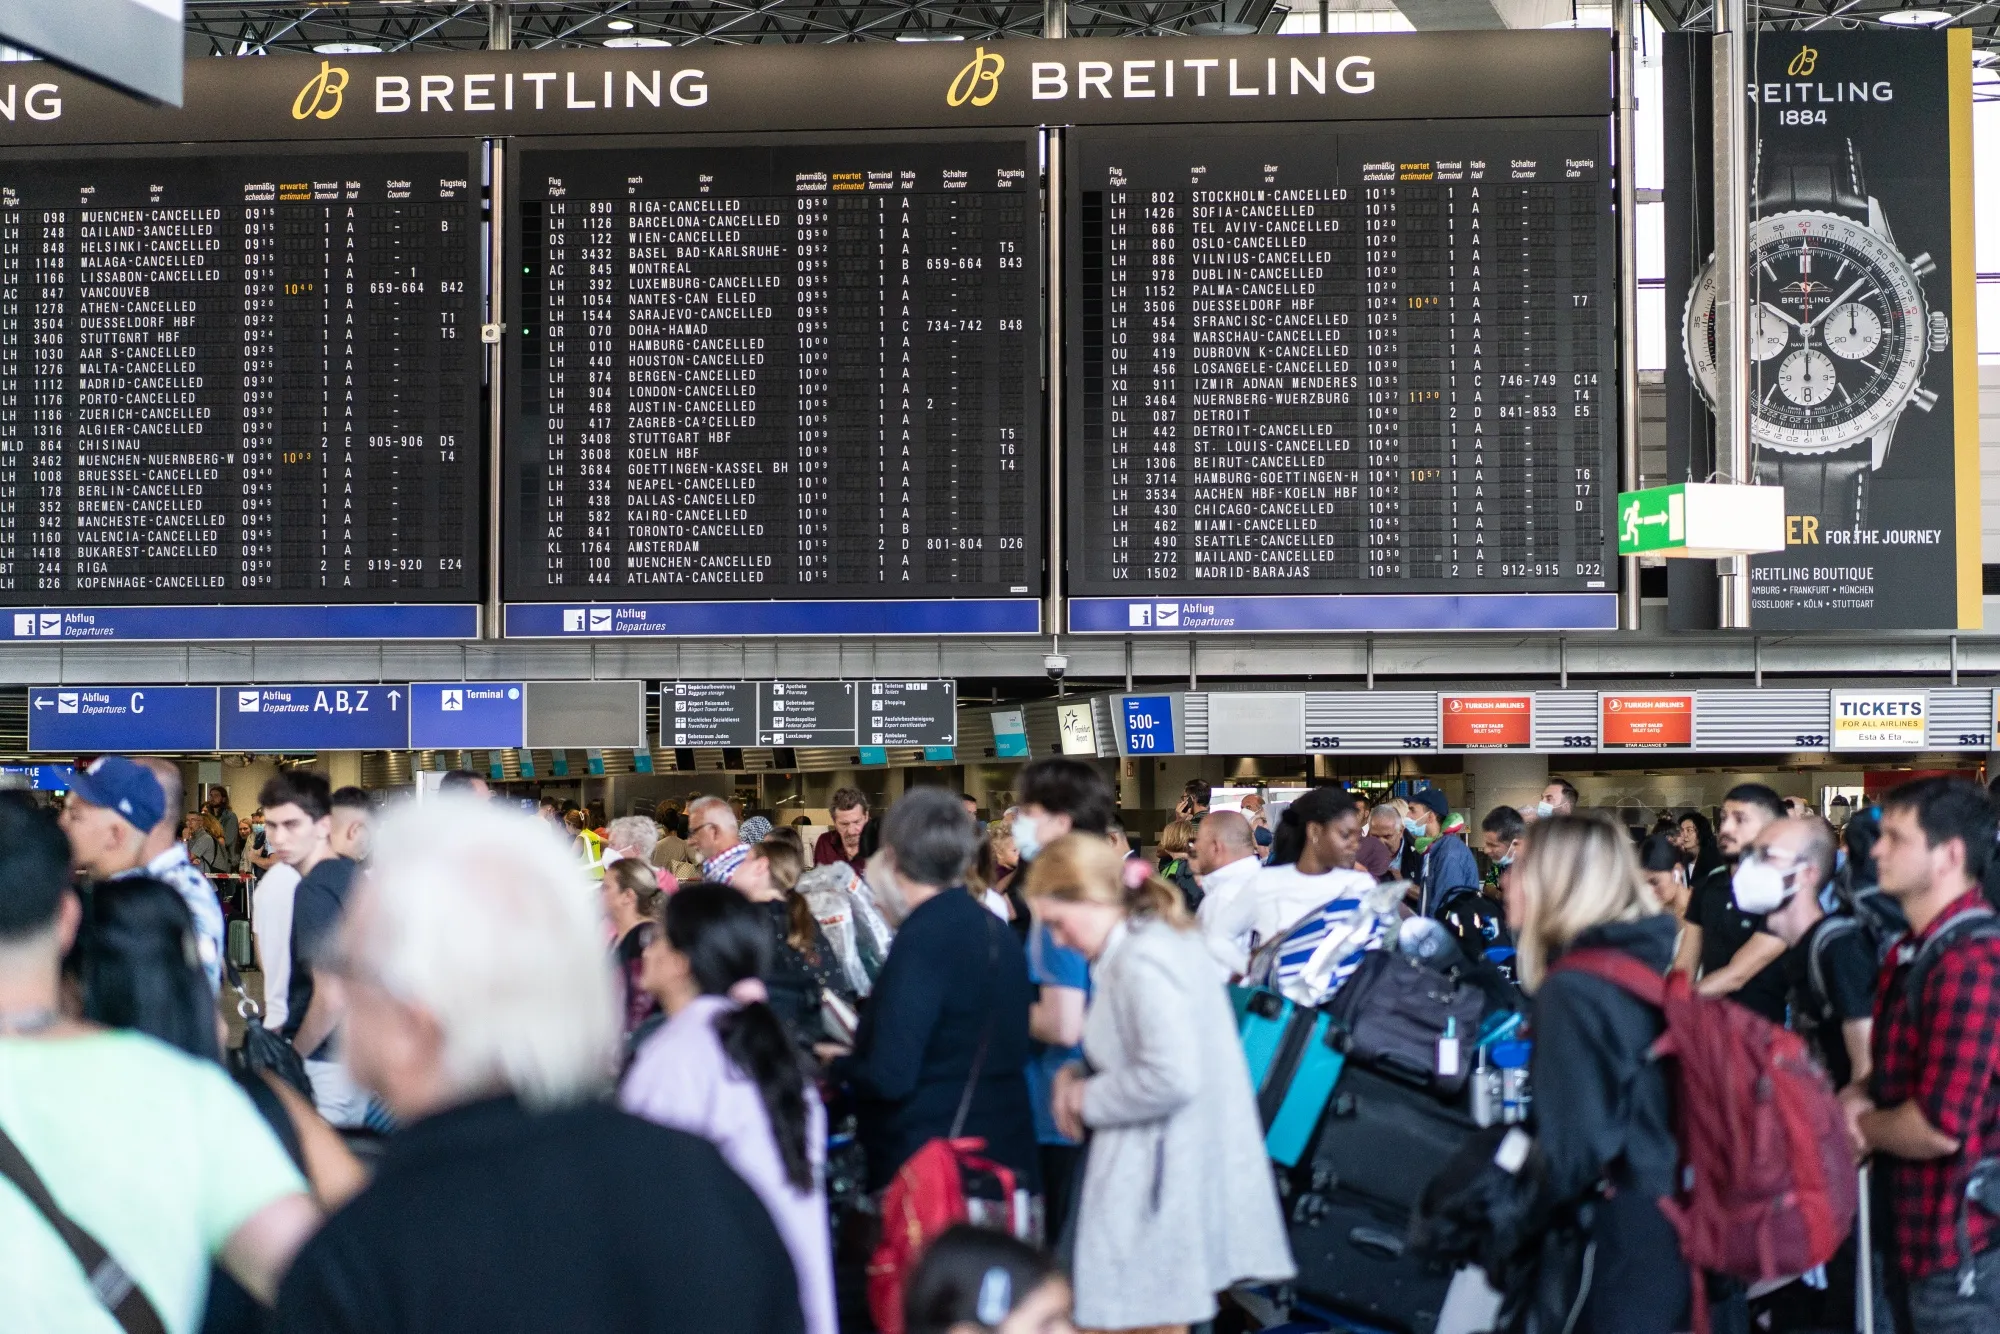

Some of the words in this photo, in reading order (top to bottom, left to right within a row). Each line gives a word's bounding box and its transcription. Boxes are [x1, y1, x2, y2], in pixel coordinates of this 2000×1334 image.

[1032, 56, 1374, 99] BREITLING
[376, 69, 707, 112] BREITLING
[1747, 81, 1894, 102] REITLING
[1779, 109, 1828, 126] 1884
[1364, 162, 1394, 172] planmäßig
[440, 180, 466, 188] Flugsteig
[549, 177, 561, 186] Flug
[1193, 189, 1346, 202] STOCKHOLM-CANCELLED
[6, 214, 18, 224] LH
[44, 212, 64, 223] 098
[82, 210, 220, 222] MUENCHEN-CANCELLED
[630, 215, 779, 228] BARCELONA-CANCELLED
[82, 240, 219, 252] HELSINKI-CANCELLED
[1193, 237, 1306, 249] OSLO-CANCELLED
[81, 255, 204, 267] MALAGA-CANCELLED
[550, 265, 564, 275] AC
[590, 264, 611, 274] 845
[630, 263, 690, 274] MONTREAL
[1000, 257, 1022, 268] B43
[36, 273, 63, 283] 1166
[82, 270, 219, 282] LISSABON-CANCELLED
[1193, 268, 1322, 280] DUBLIN-CANCELLED
[81, 287, 149, 297] VANCOUVEB
[371, 282, 424, 293] 659-664
[442, 282, 463, 292] B42
[81, 301, 195, 313] ATHEN-CANCELLED
[81, 317, 164, 328] DUESSELDORF
[174, 316, 195, 326] HBF
[441, 313, 454, 322] T1
[630, 324, 707, 335] DOHA-HAMAD
[928, 320, 981, 331] 734-742
[1000, 320, 1022, 330] B48
[630, 338, 764, 350] HAMBURG-CANCELLED
[80, 377, 202, 389] MADRID-CANCELLED
[1196, 378, 1233, 389] IZMIR
[1243, 378, 1282, 388] ADNAN
[1293, 377, 1356, 388] MENDERES
[1574, 374, 1597, 385] C14
[630, 385, 755, 397] LONDON-CANCELLED
[80, 408, 210, 419] ZUERICH-CANCELLED
[1194, 410, 1250, 420] DETROIT
[1500, 406, 1556, 417] 841-853
[1575, 406, 1589, 416] E5
[79, 440, 139, 450] CHISINAU
[370, 436, 422, 446] 905-906
[440, 436, 454, 446] D5
[629, 432, 699, 444] STUTTGART
[709, 432, 730, 442] HBF
[79, 485, 202, 496] BERLIN-CANCELLED
[628, 494, 754, 505] DALLAS-CANCELLED
[1195, 503, 1333, 515] CHICAGO-CANCELLED
[1195, 519, 1316, 530] MIAMI-CANCELLED
[1785, 516, 1819, 544] ER
[1825, 530, 1850, 544] FOR
[1854, 530, 1880, 544] THE
[1882, 530, 1942, 544] JOURNEY
[628, 541, 698, 552] AMSTERDAM
[928, 538, 982, 549] 801-804
[1001, 538, 1022, 548] D26
[78, 562, 107, 572] RIGA
[369, 560, 422, 570] 919-920
[440, 559, 461, 569] E24
[1196, 566, 1309, 577] MADRID-BARAJAS
[1577, 564, 1600, 574] D22
[628, 572, 763, 583] ATLANTA-CANCELLED
[1813, 568, 1874, 581] BOUTIQUE
[78, 576, 224, 588] KOPENHAGE-CANCELLED
[1752, 586, 1780, 594] AMBURG
[1790, 586, 1830, 594] FRANKFURT
[1840, 584, 1874, 594] MÜNCHEN
[1183, 604, 1214, 615] Abflug
[1752, 599, 1794, 608] ÜSSELDORF
[1804, 599, 1823, 608] KÖLN
[1832, 600, 1874, 608] STUTTGART
[65, 614, 94, 624] Abflug
[616, 609, 646, 620] Abflug
[616, 622, 666, 632] Departures
[1183, 617, 1234, 628] Departures
[65, 626, 114, 637] Departures
[263, 691, 291, 702] Abflug
[466, 690, 503, 698] Terminal
[82, 693, 109, 703] Abflug
[131, 692, 144, 713] C
[263, 703, 309, 713] Departures
[82, 705, 126, 715] Departures
[1840, 702, 1922, 716] TICKETS
[1130, 714, 1159, 729] 500-
[1132, 734, 1154, 748] 570
[1311, 736, 1340, 748] 535
[1402, 737, 1431, 748] 534
[1563, 736, 1591, 747] 533
[1795, 735, 1824, 746] 532
[1959, 734, 1986, 745] 531
